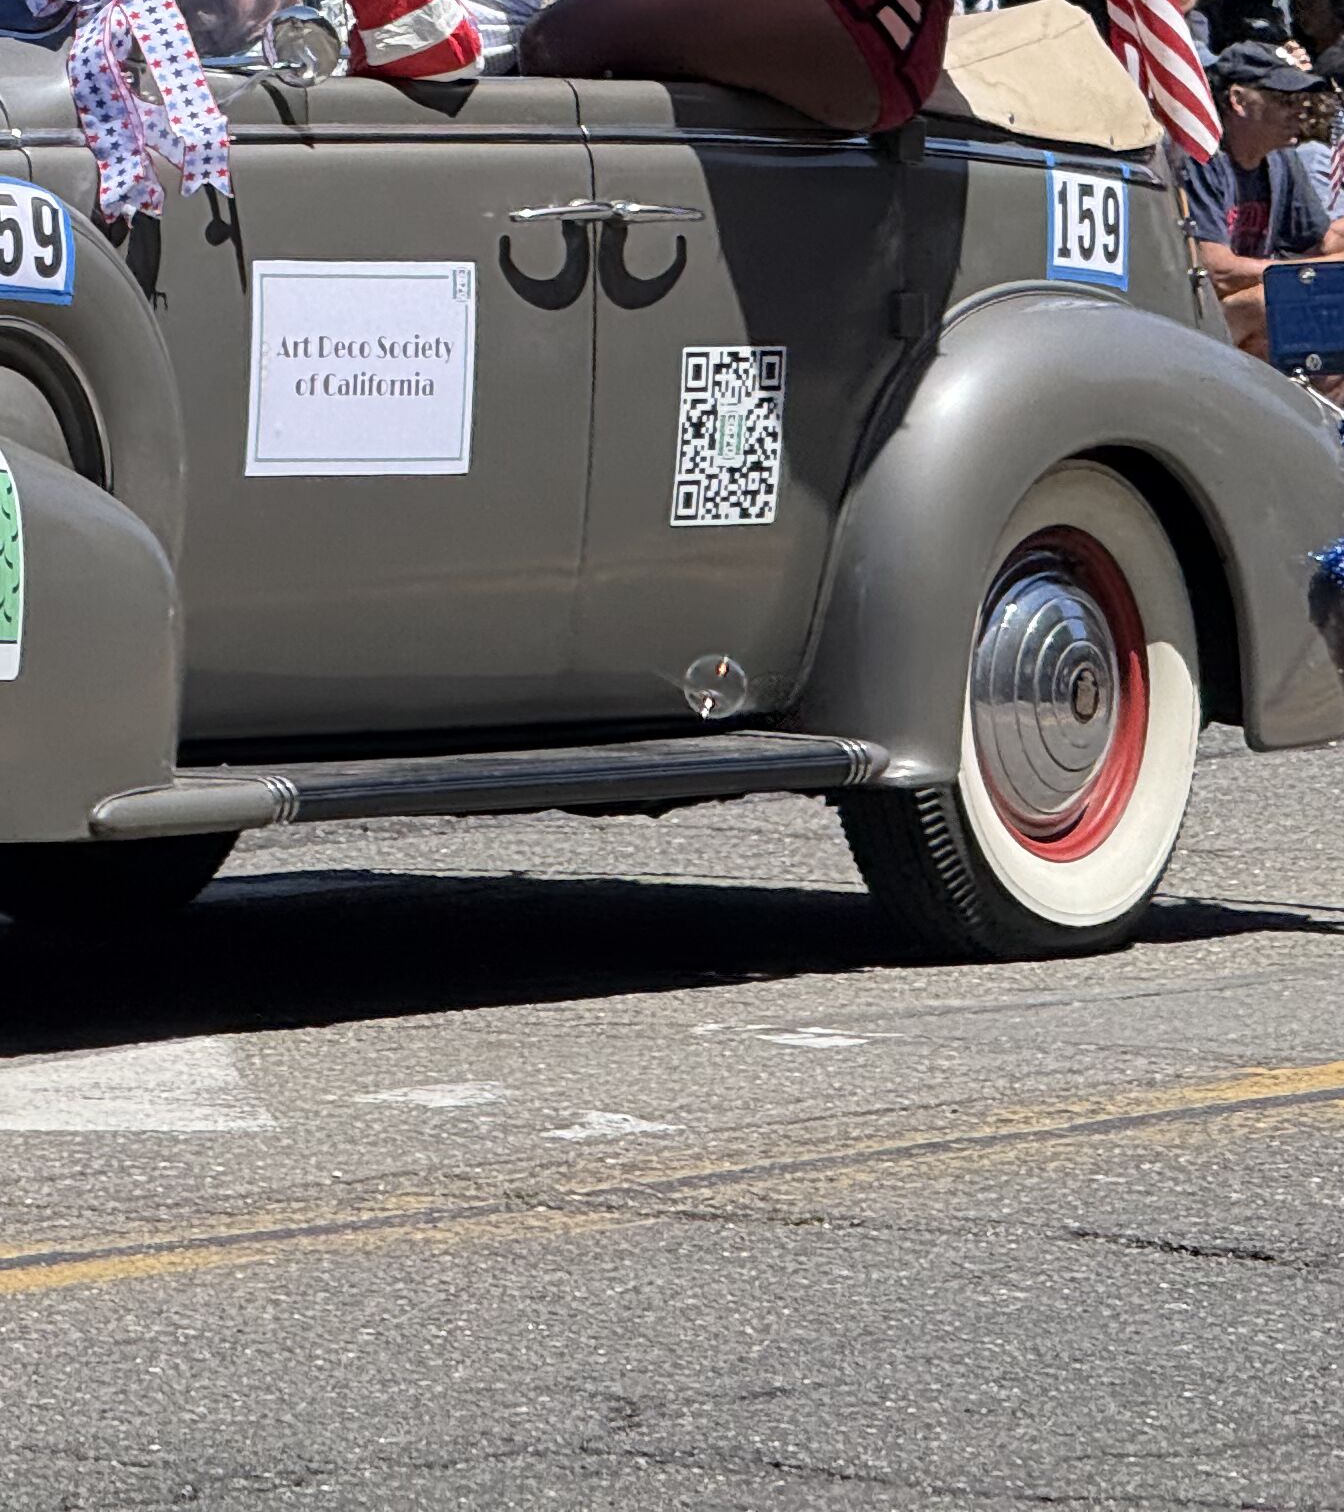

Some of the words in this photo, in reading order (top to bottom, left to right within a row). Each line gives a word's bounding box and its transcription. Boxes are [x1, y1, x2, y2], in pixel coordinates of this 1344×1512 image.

[1057, 180, 1120, 264] 159
[276, 335, 312, 359] Art
[318, 335, 371, 359] Deco
[376, 334, 454, 364] Society
[295, 373, 319, 397] of
[323, 371, 435, 397] California
